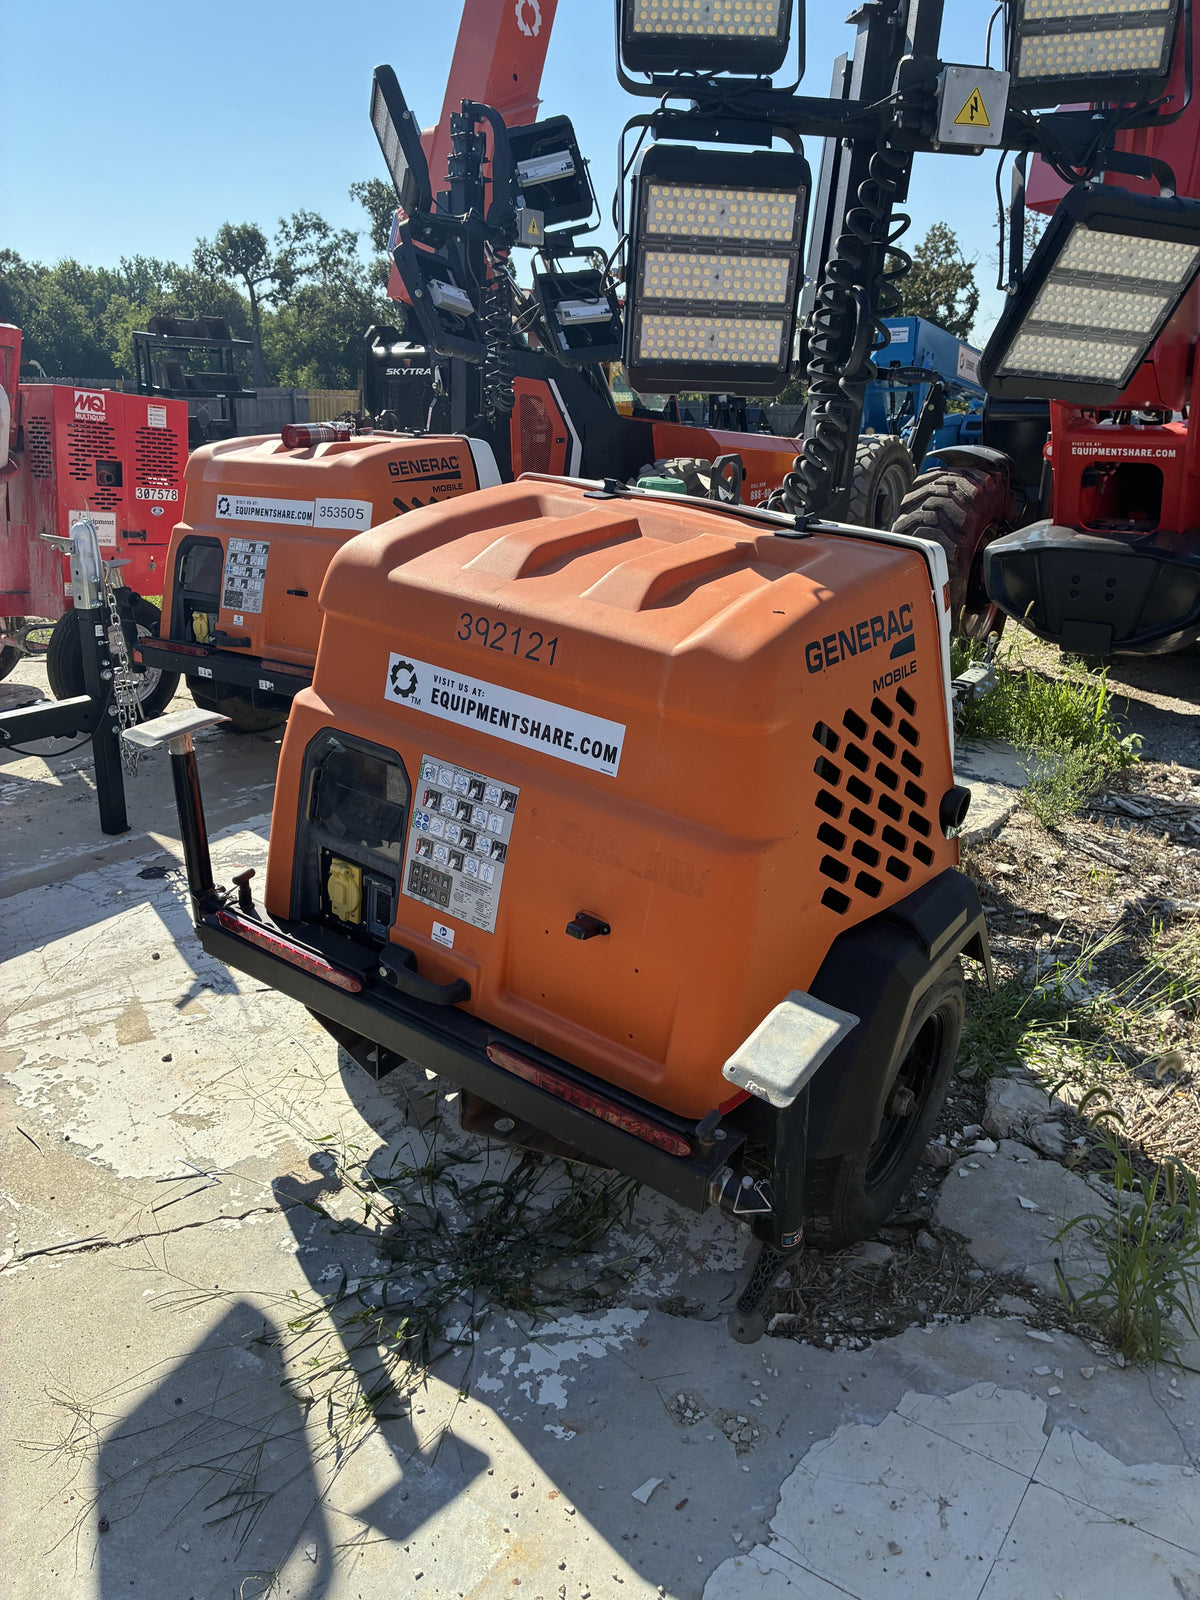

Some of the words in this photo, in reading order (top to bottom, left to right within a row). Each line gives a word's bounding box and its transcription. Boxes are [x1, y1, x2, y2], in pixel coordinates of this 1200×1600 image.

[386, 367, 432, 376] SKYTRA
[74, 392, 105, 414] MQ
[75, 413, 106, 422] MULTIQUIP
[1071, 447, 1177, 458] EQUIPMENTSHARE.COM
[388, 456, 460, 476] GENERAC
[136, 487, 177, 500] 307578
[432, 483, 463, 493] MOBILE
[235, 506, 313, 521] EQUIPMENTSHARE.COM
[319, 505, 365, 520] 353505
[457, 612, 559, 666] 392121
[804, 603, 914, 674] GENERAC
[872, 659, 918, 694] MOBILE
[432, 674, 456, 689] VISIT
[458, 681, 470, 693] US
[471, 687, 486, 698] AT:
[430, 687, 619, 765] EQUIPMENTSHARE.COM
